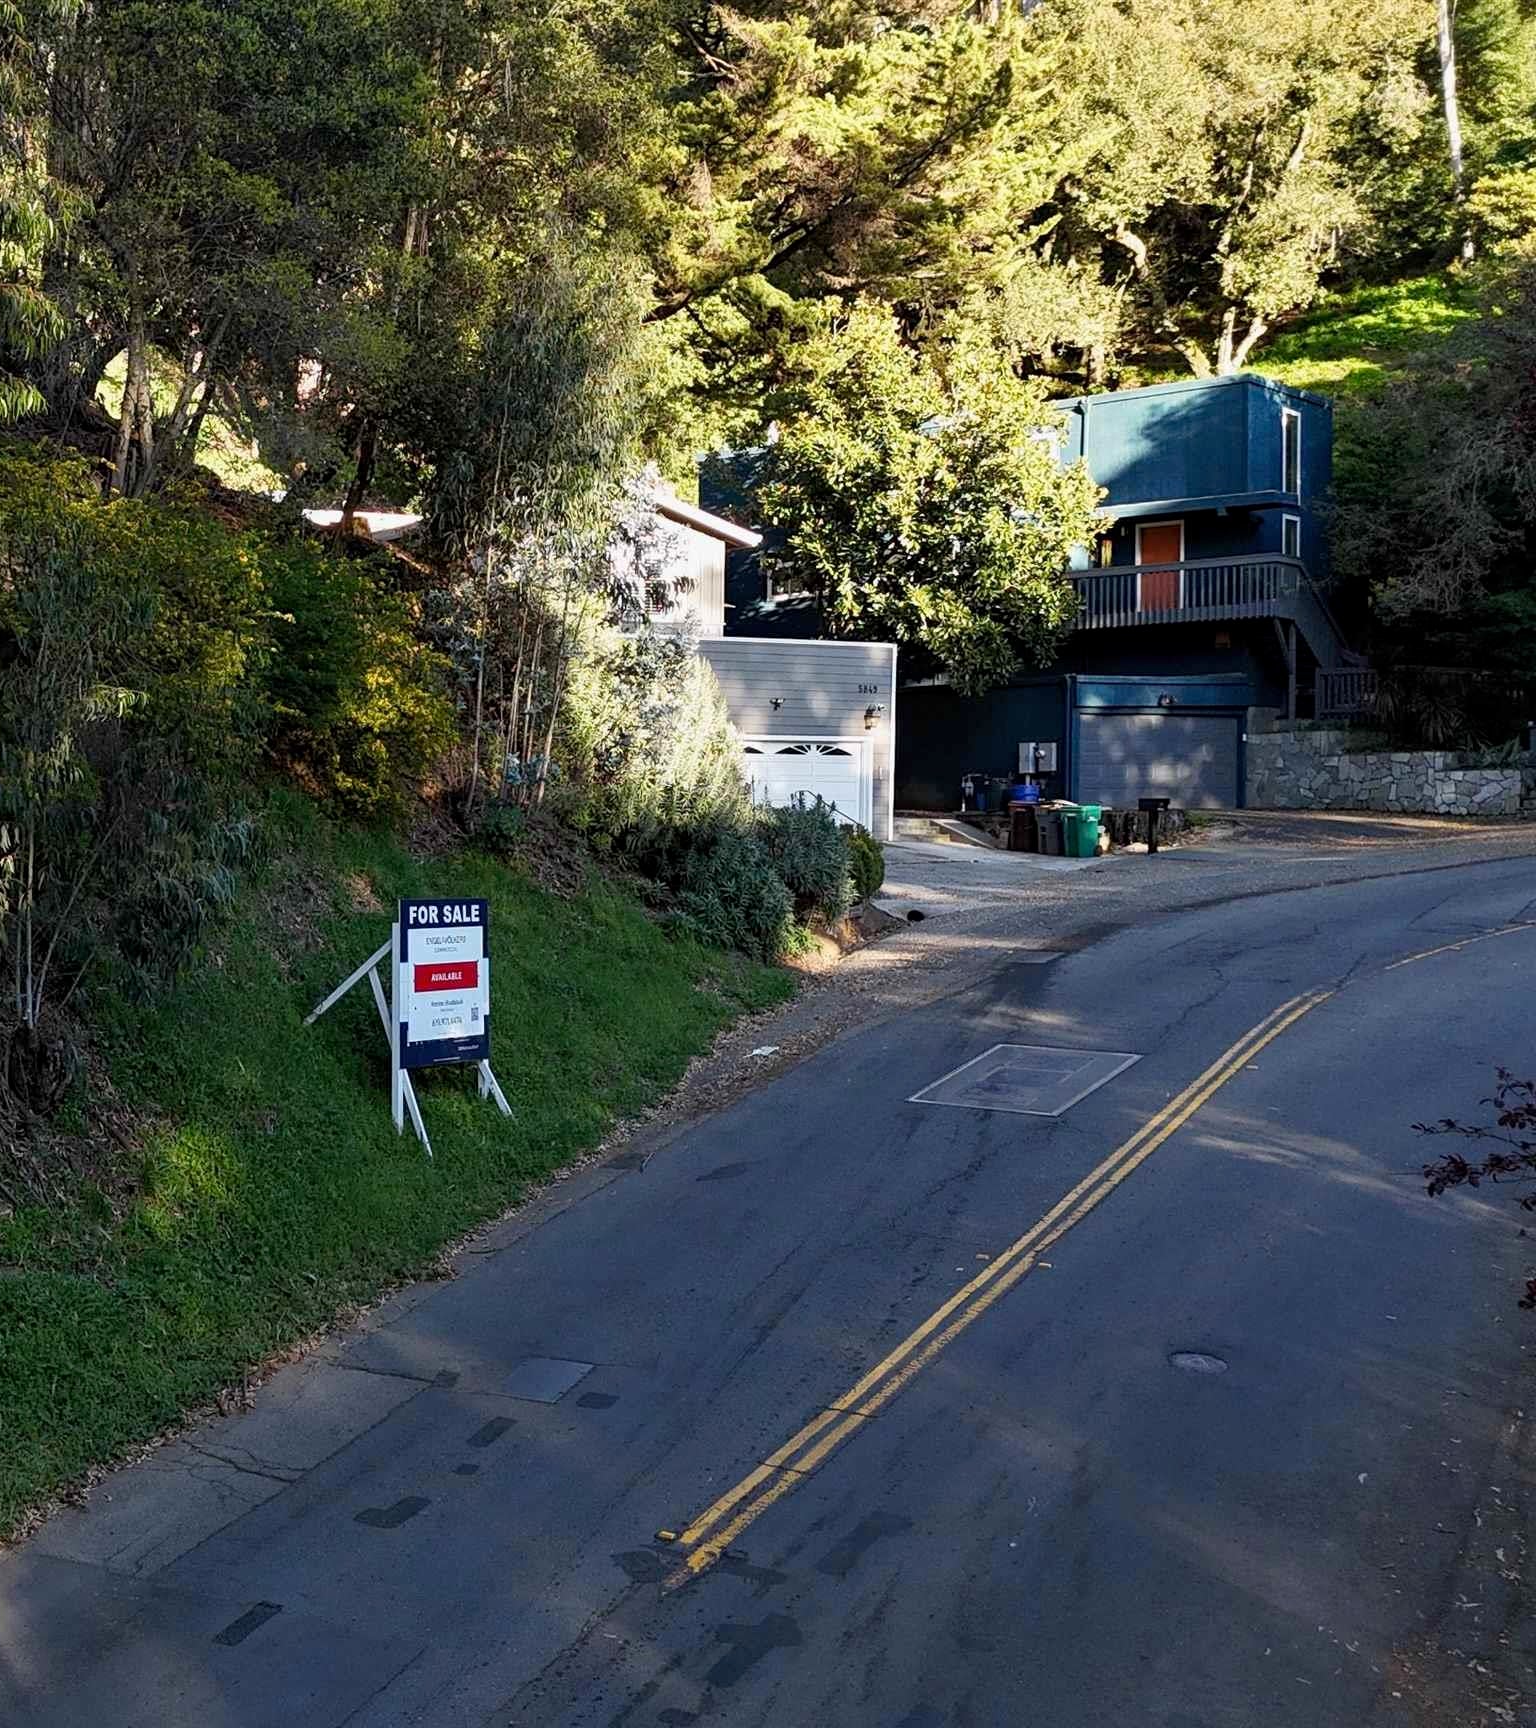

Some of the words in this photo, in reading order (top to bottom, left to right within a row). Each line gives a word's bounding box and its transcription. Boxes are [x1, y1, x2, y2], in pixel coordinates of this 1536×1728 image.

[409, 906, 439, 925] FOR
[443, 904, 480, 923] SALE
[431, 971, 463, 982] AVAILABLE
